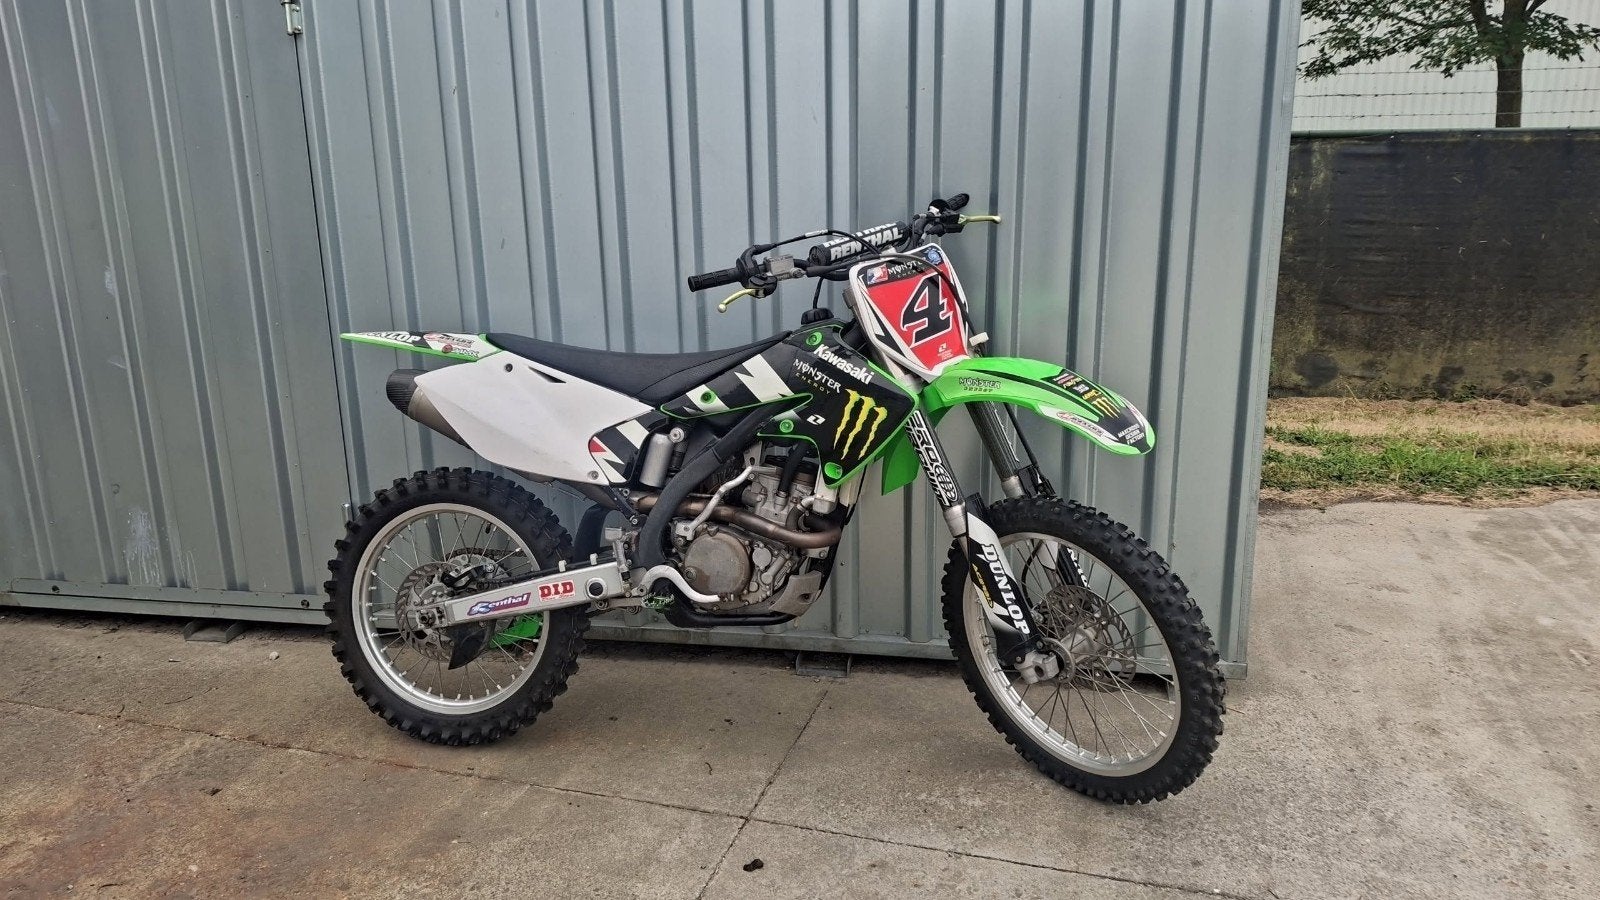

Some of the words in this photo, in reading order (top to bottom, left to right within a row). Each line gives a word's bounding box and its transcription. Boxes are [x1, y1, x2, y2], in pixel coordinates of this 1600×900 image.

[901, 271, 953, 348] 4
[793, 359, 841, 393] MONSTER
[814, 344, 874, 385] Kawasaki
[959, 376, 1002, 390] MONSTER
[981, 544, 1030, 634] DUNLOP
